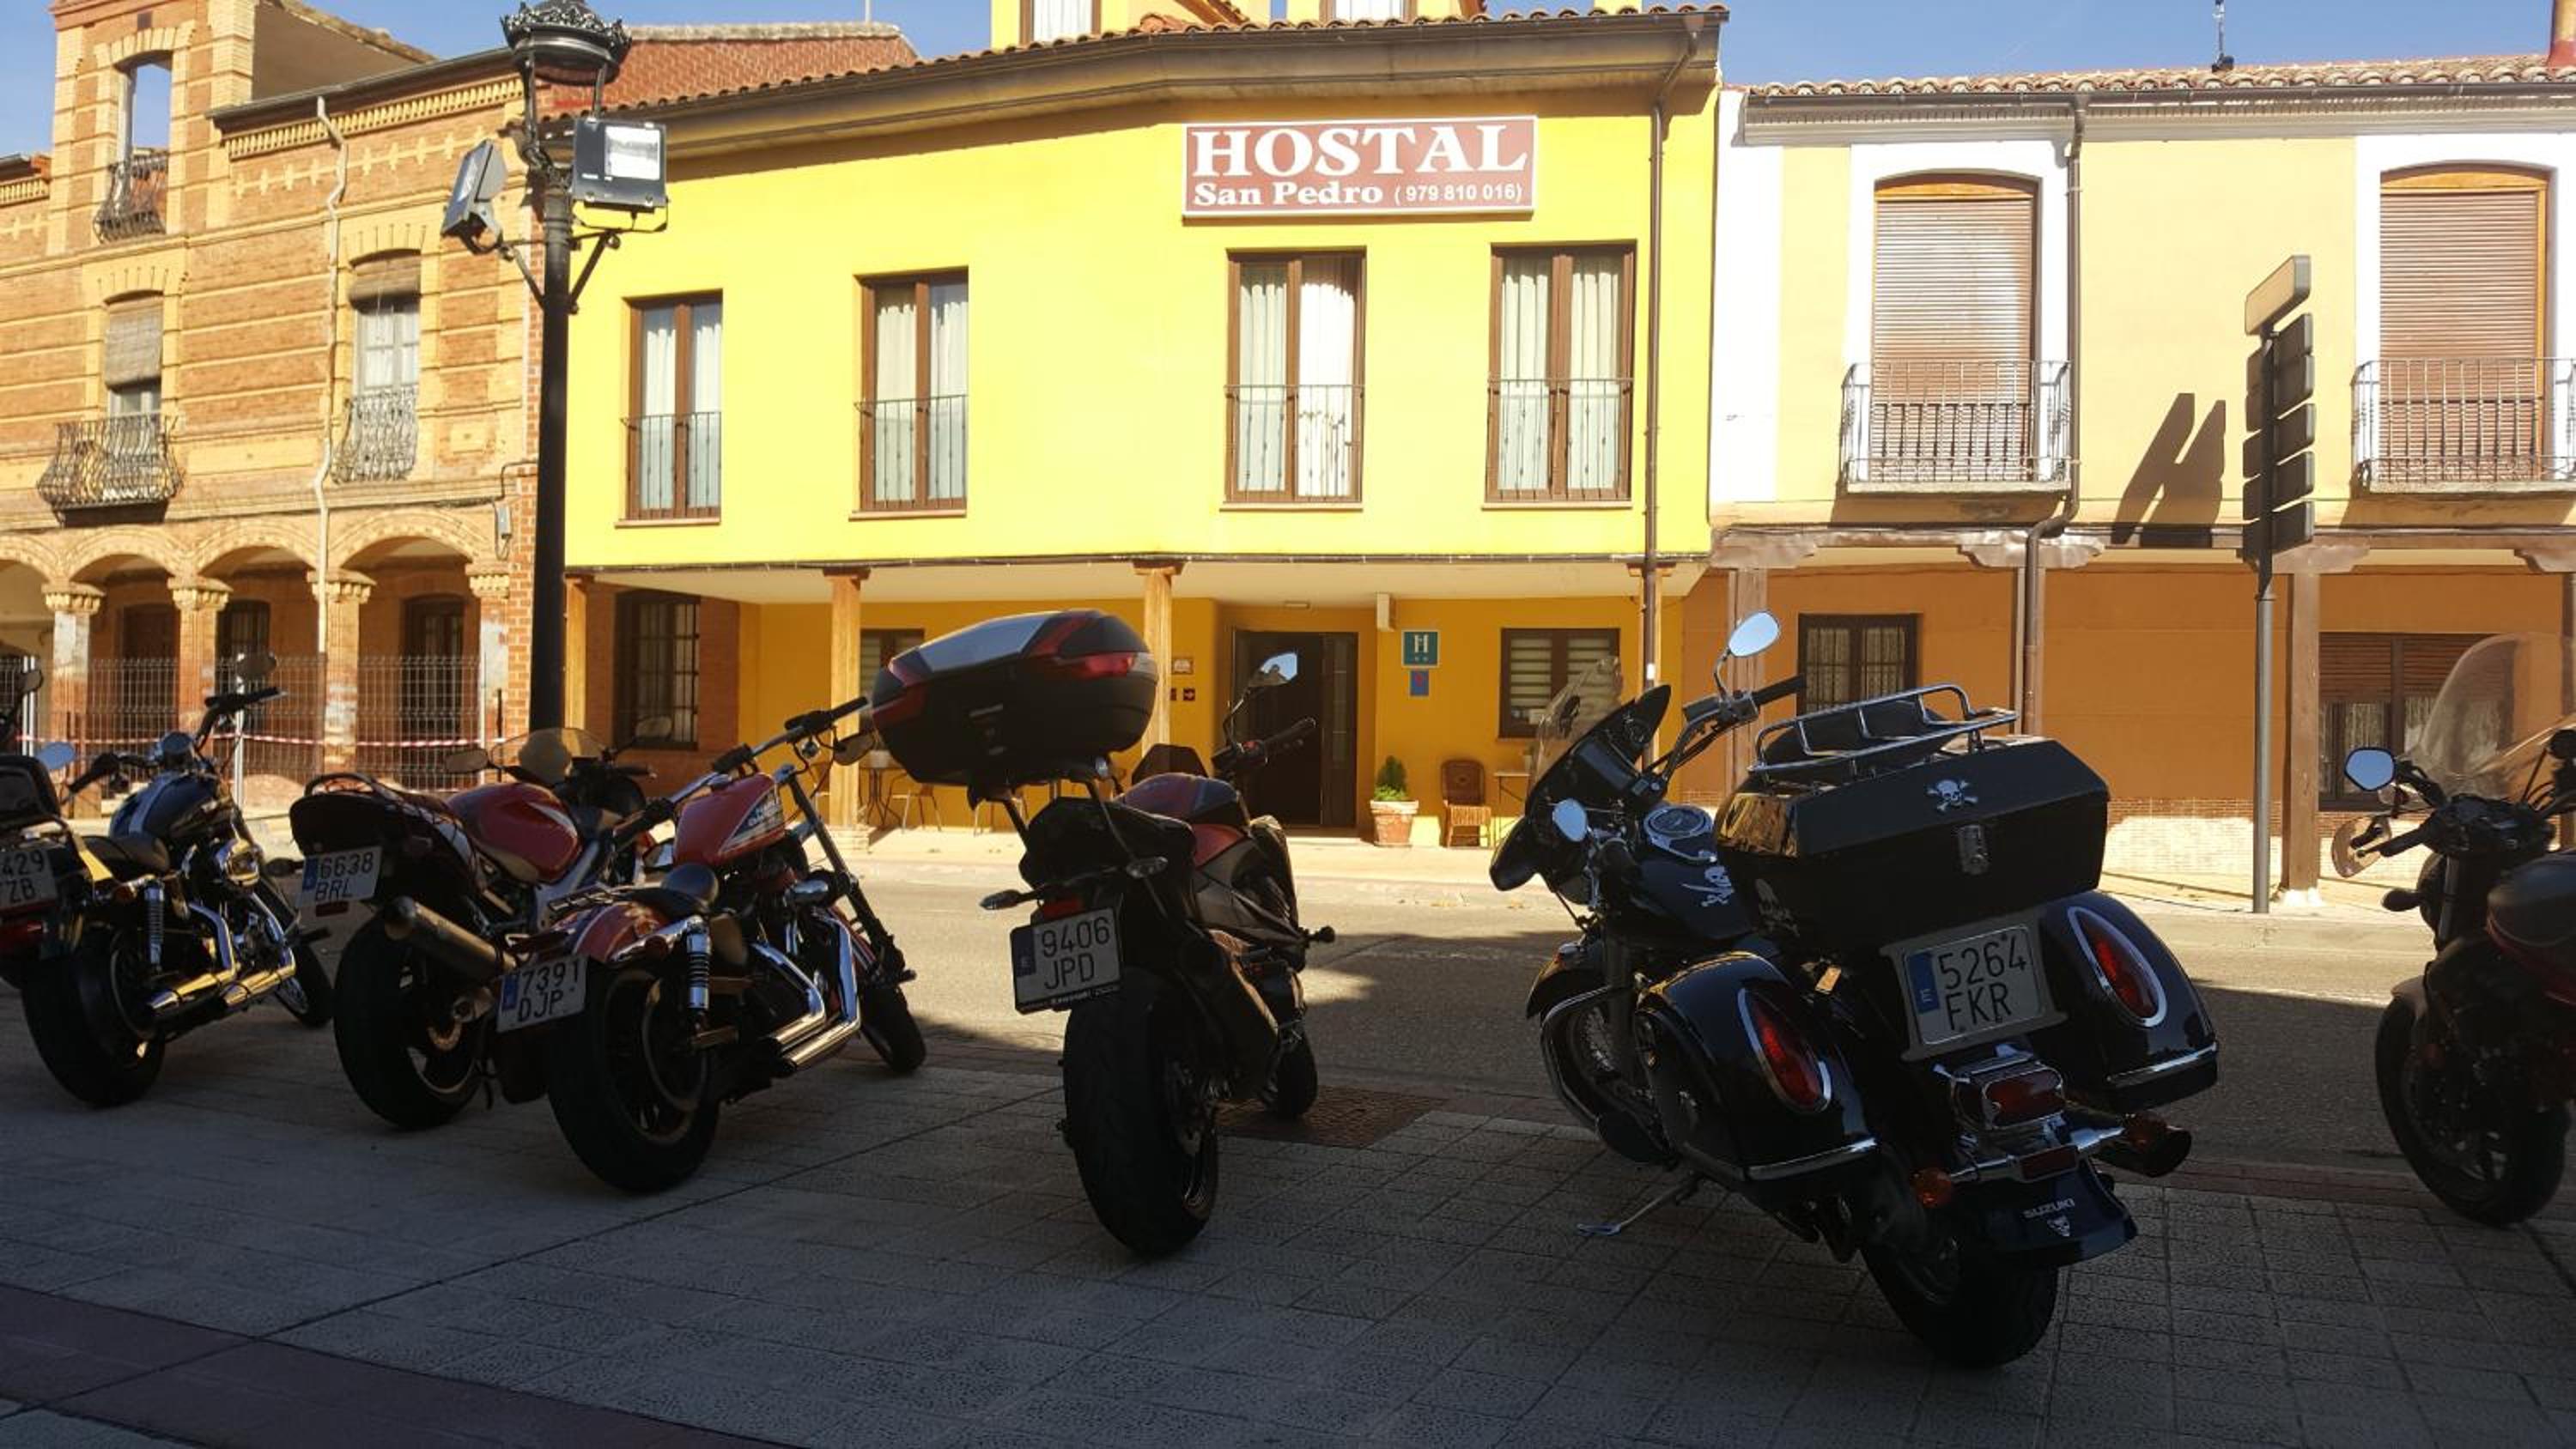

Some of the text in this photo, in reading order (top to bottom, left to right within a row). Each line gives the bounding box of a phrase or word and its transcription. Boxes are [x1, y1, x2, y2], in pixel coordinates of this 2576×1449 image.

[1192, 124, 1528, 177] HOSTAL
[1194, 182, 1264, 206] San
[1273, 181, 1383, 204] Pedro
[1444, 184, 1477, 202] 810
[1483, 181, 1522, 203] 016)
[320, 852, 373, 878] 6638
[0, 878, 35, 904] ZB
[315, 878, 353, 901] BRL
[1042, 917, 1110, 958] 9406
[522, 961, 578, 995] 7391
[1044, 953, 1094, 990] JPD
[1938, 935, 2026, 991] 5264
[518, 990, 563, 1022] DJP
[1920, 988, 1933, 1003] E
[1946, 983, 2012, 1030] FKR
[2021, 1197, 2075, 1218] SUZUKI
